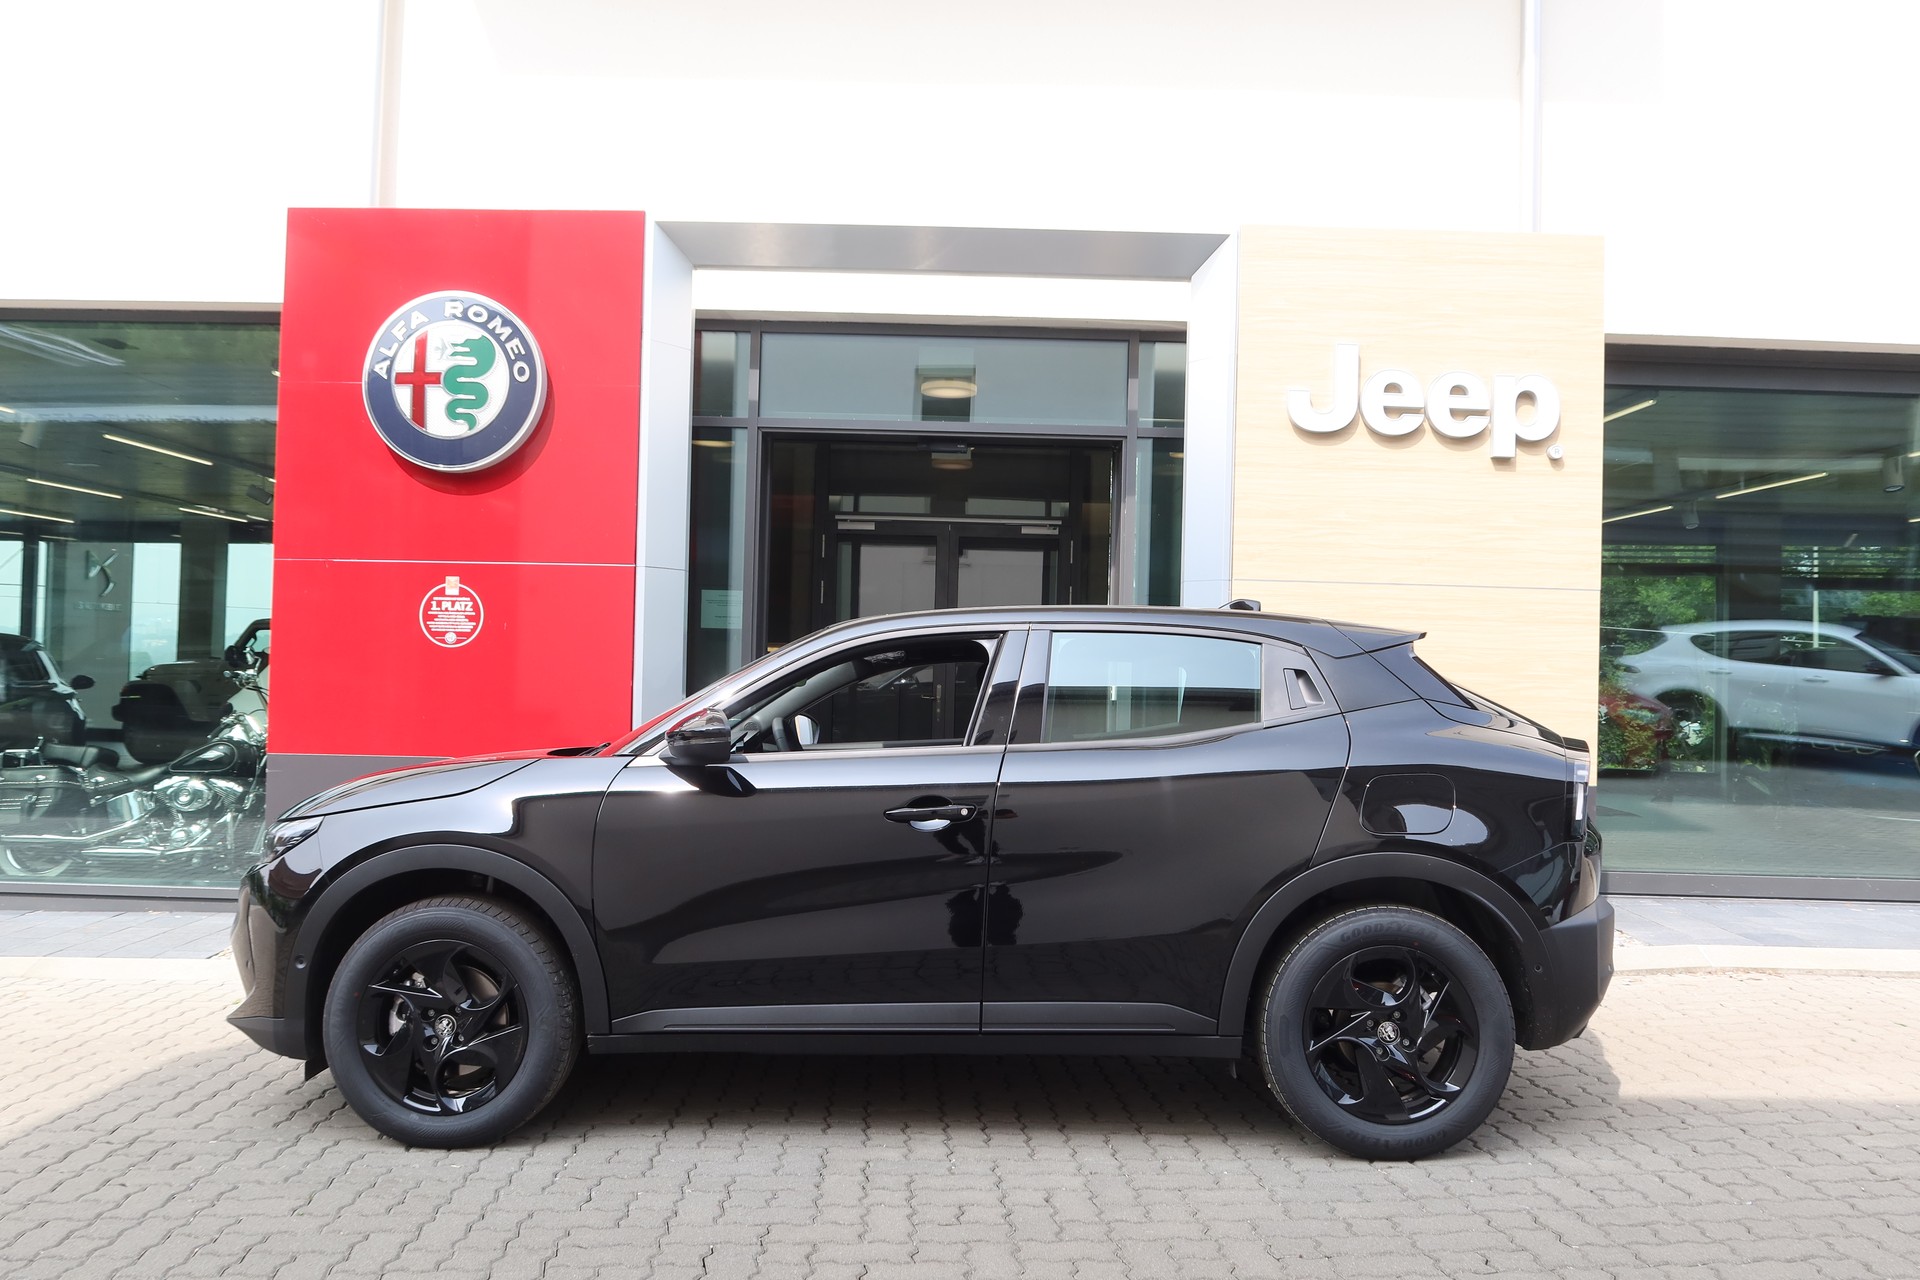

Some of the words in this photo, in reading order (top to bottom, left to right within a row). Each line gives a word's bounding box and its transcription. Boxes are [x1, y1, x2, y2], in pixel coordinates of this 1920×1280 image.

[373, 310, 430, 380] ALFA
[444, 300, 531, 383] ROMEO
[1287, 343, 1561, 460] Jeep
[441, 601, 474, 611] PLATZ
[1340, 920, 1438, 943] GOODYEAR
